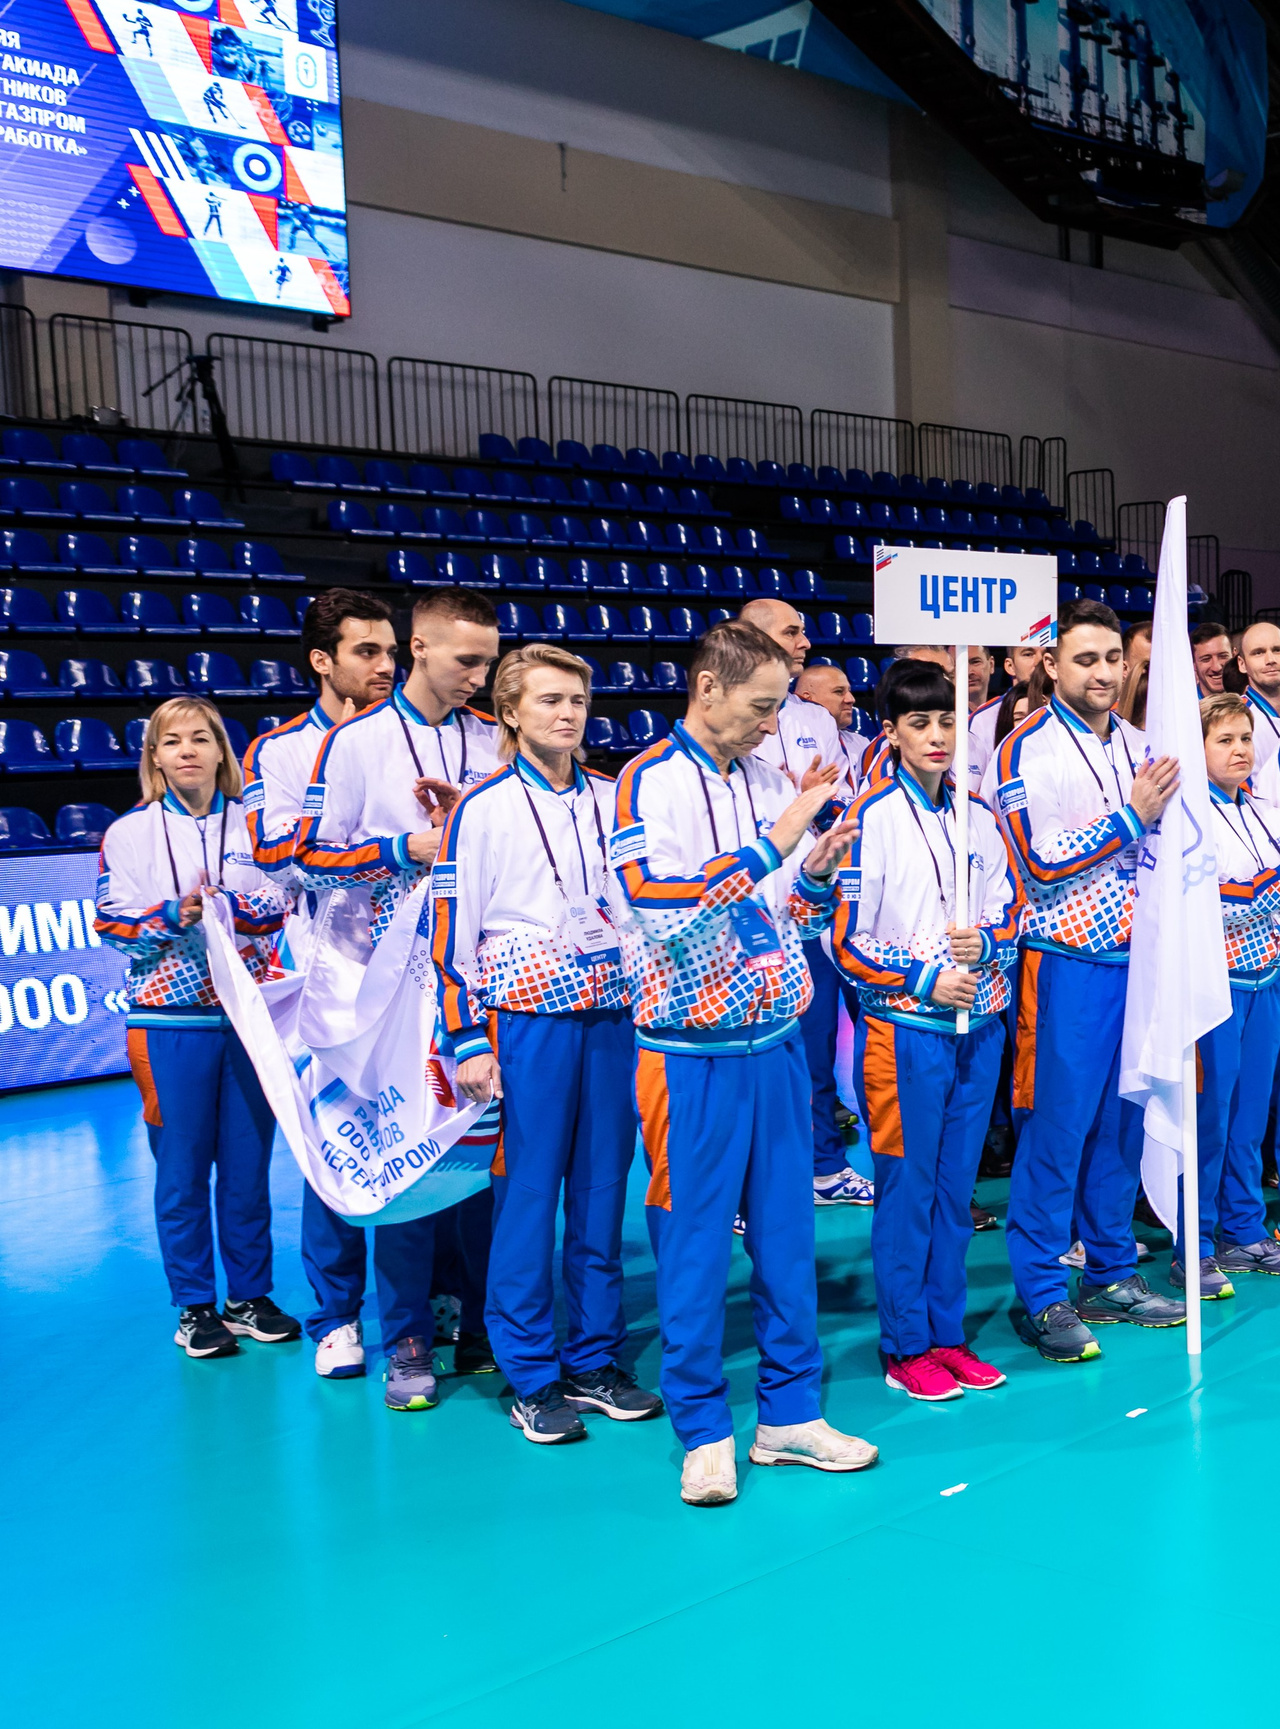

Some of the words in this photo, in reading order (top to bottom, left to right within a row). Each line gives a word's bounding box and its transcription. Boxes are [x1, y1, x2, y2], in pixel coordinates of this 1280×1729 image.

[0, 53, 81, 86] АКИАДА
[0, 77, 68, 106] НИКОВ
[920, 574, 1018, 619] ЦЕНТР
[374, 1138, 442, 1187] ПРОМ
